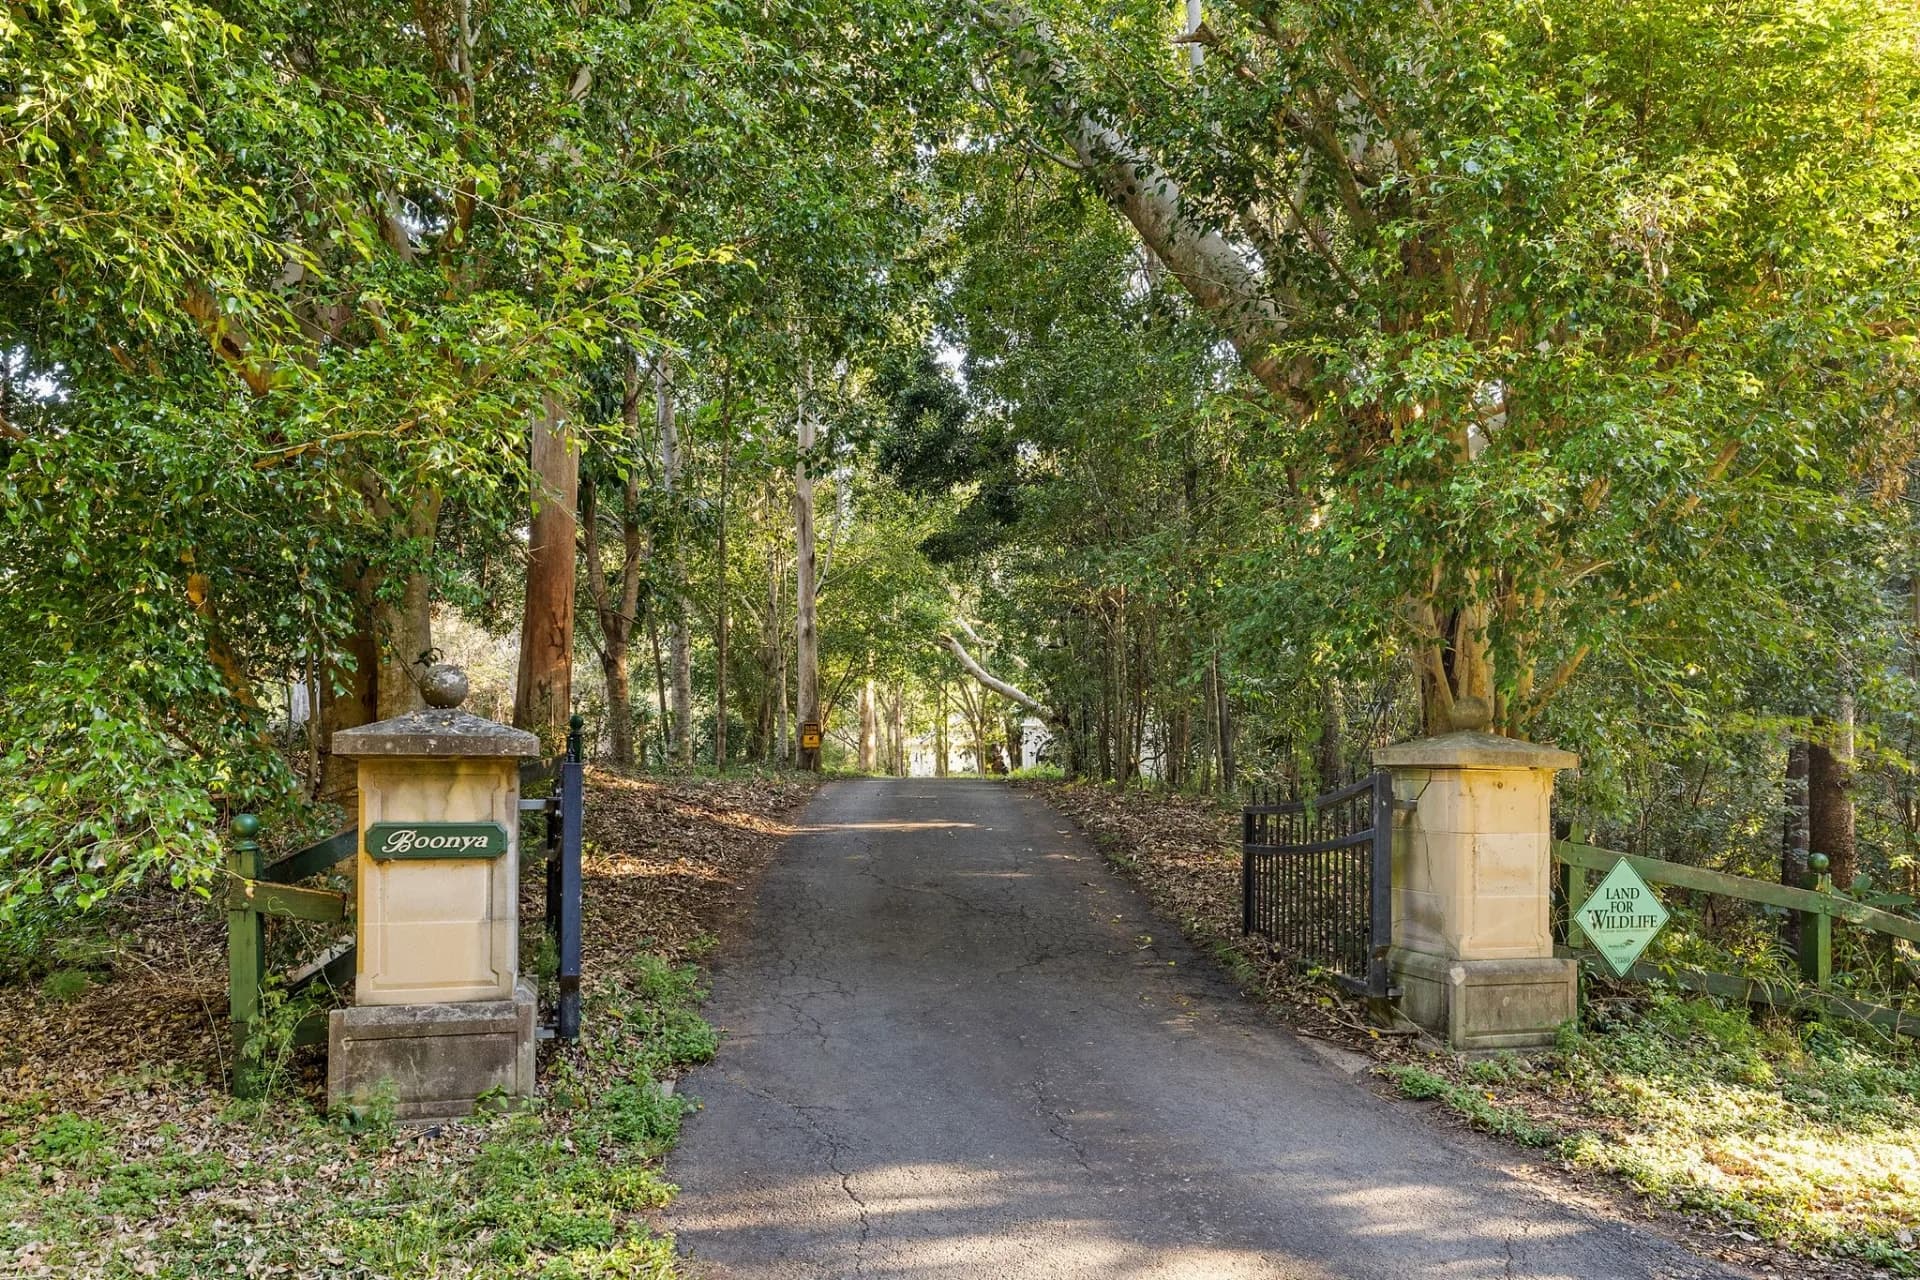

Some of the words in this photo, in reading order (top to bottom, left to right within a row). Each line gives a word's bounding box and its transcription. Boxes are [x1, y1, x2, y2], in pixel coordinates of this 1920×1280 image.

[381, 830, 489, 853] Boonya
[1606, 888, 1640, 900] LAND
[1611, 901, 1634, 913] FOR
[1587, 910, 1658, 929] WILDLIFE
